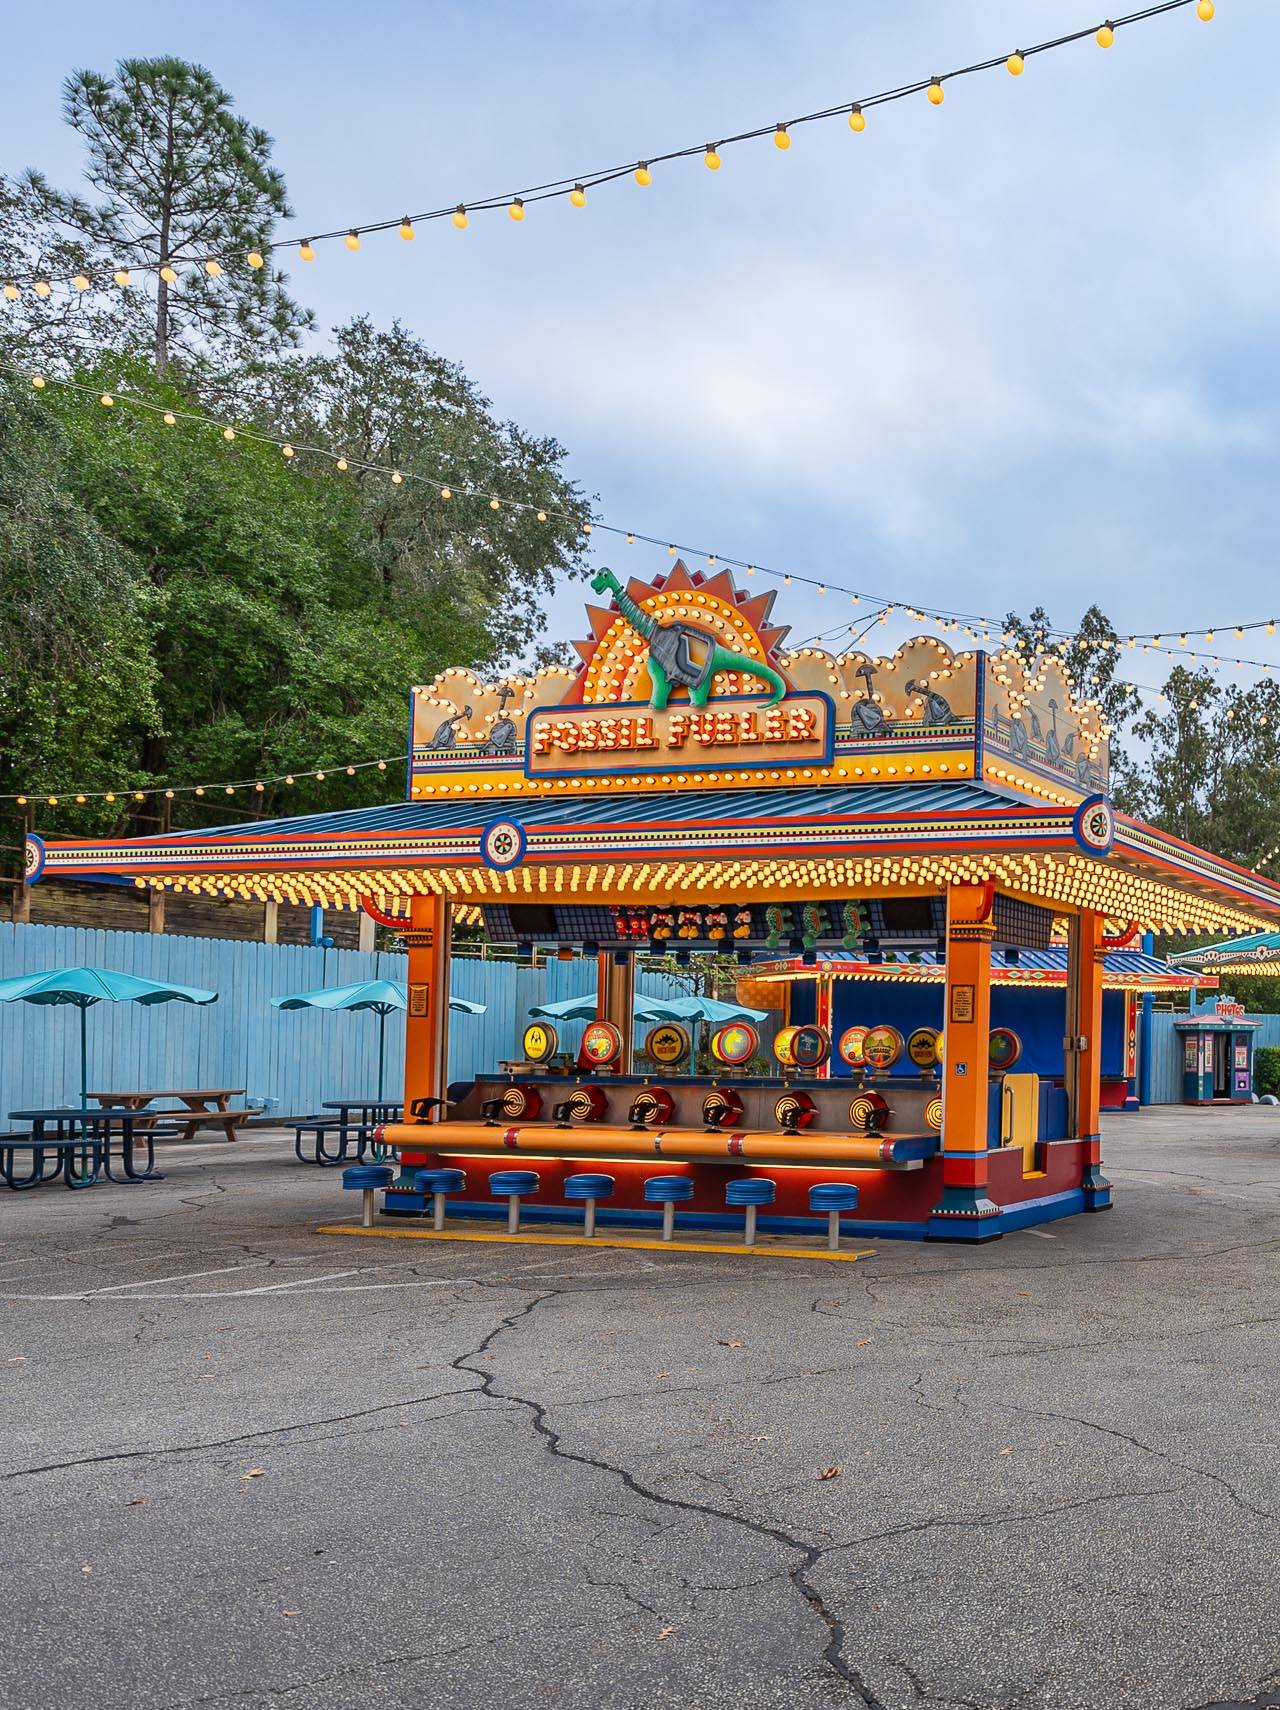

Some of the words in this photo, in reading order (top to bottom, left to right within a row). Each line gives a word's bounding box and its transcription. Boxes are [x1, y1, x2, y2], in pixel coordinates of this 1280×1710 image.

[533, 717, 659, 754] FOSSIL
[666, 708, 820, 748] FUELER
[1215, 1003, 1244, 1017] PHOTOS
